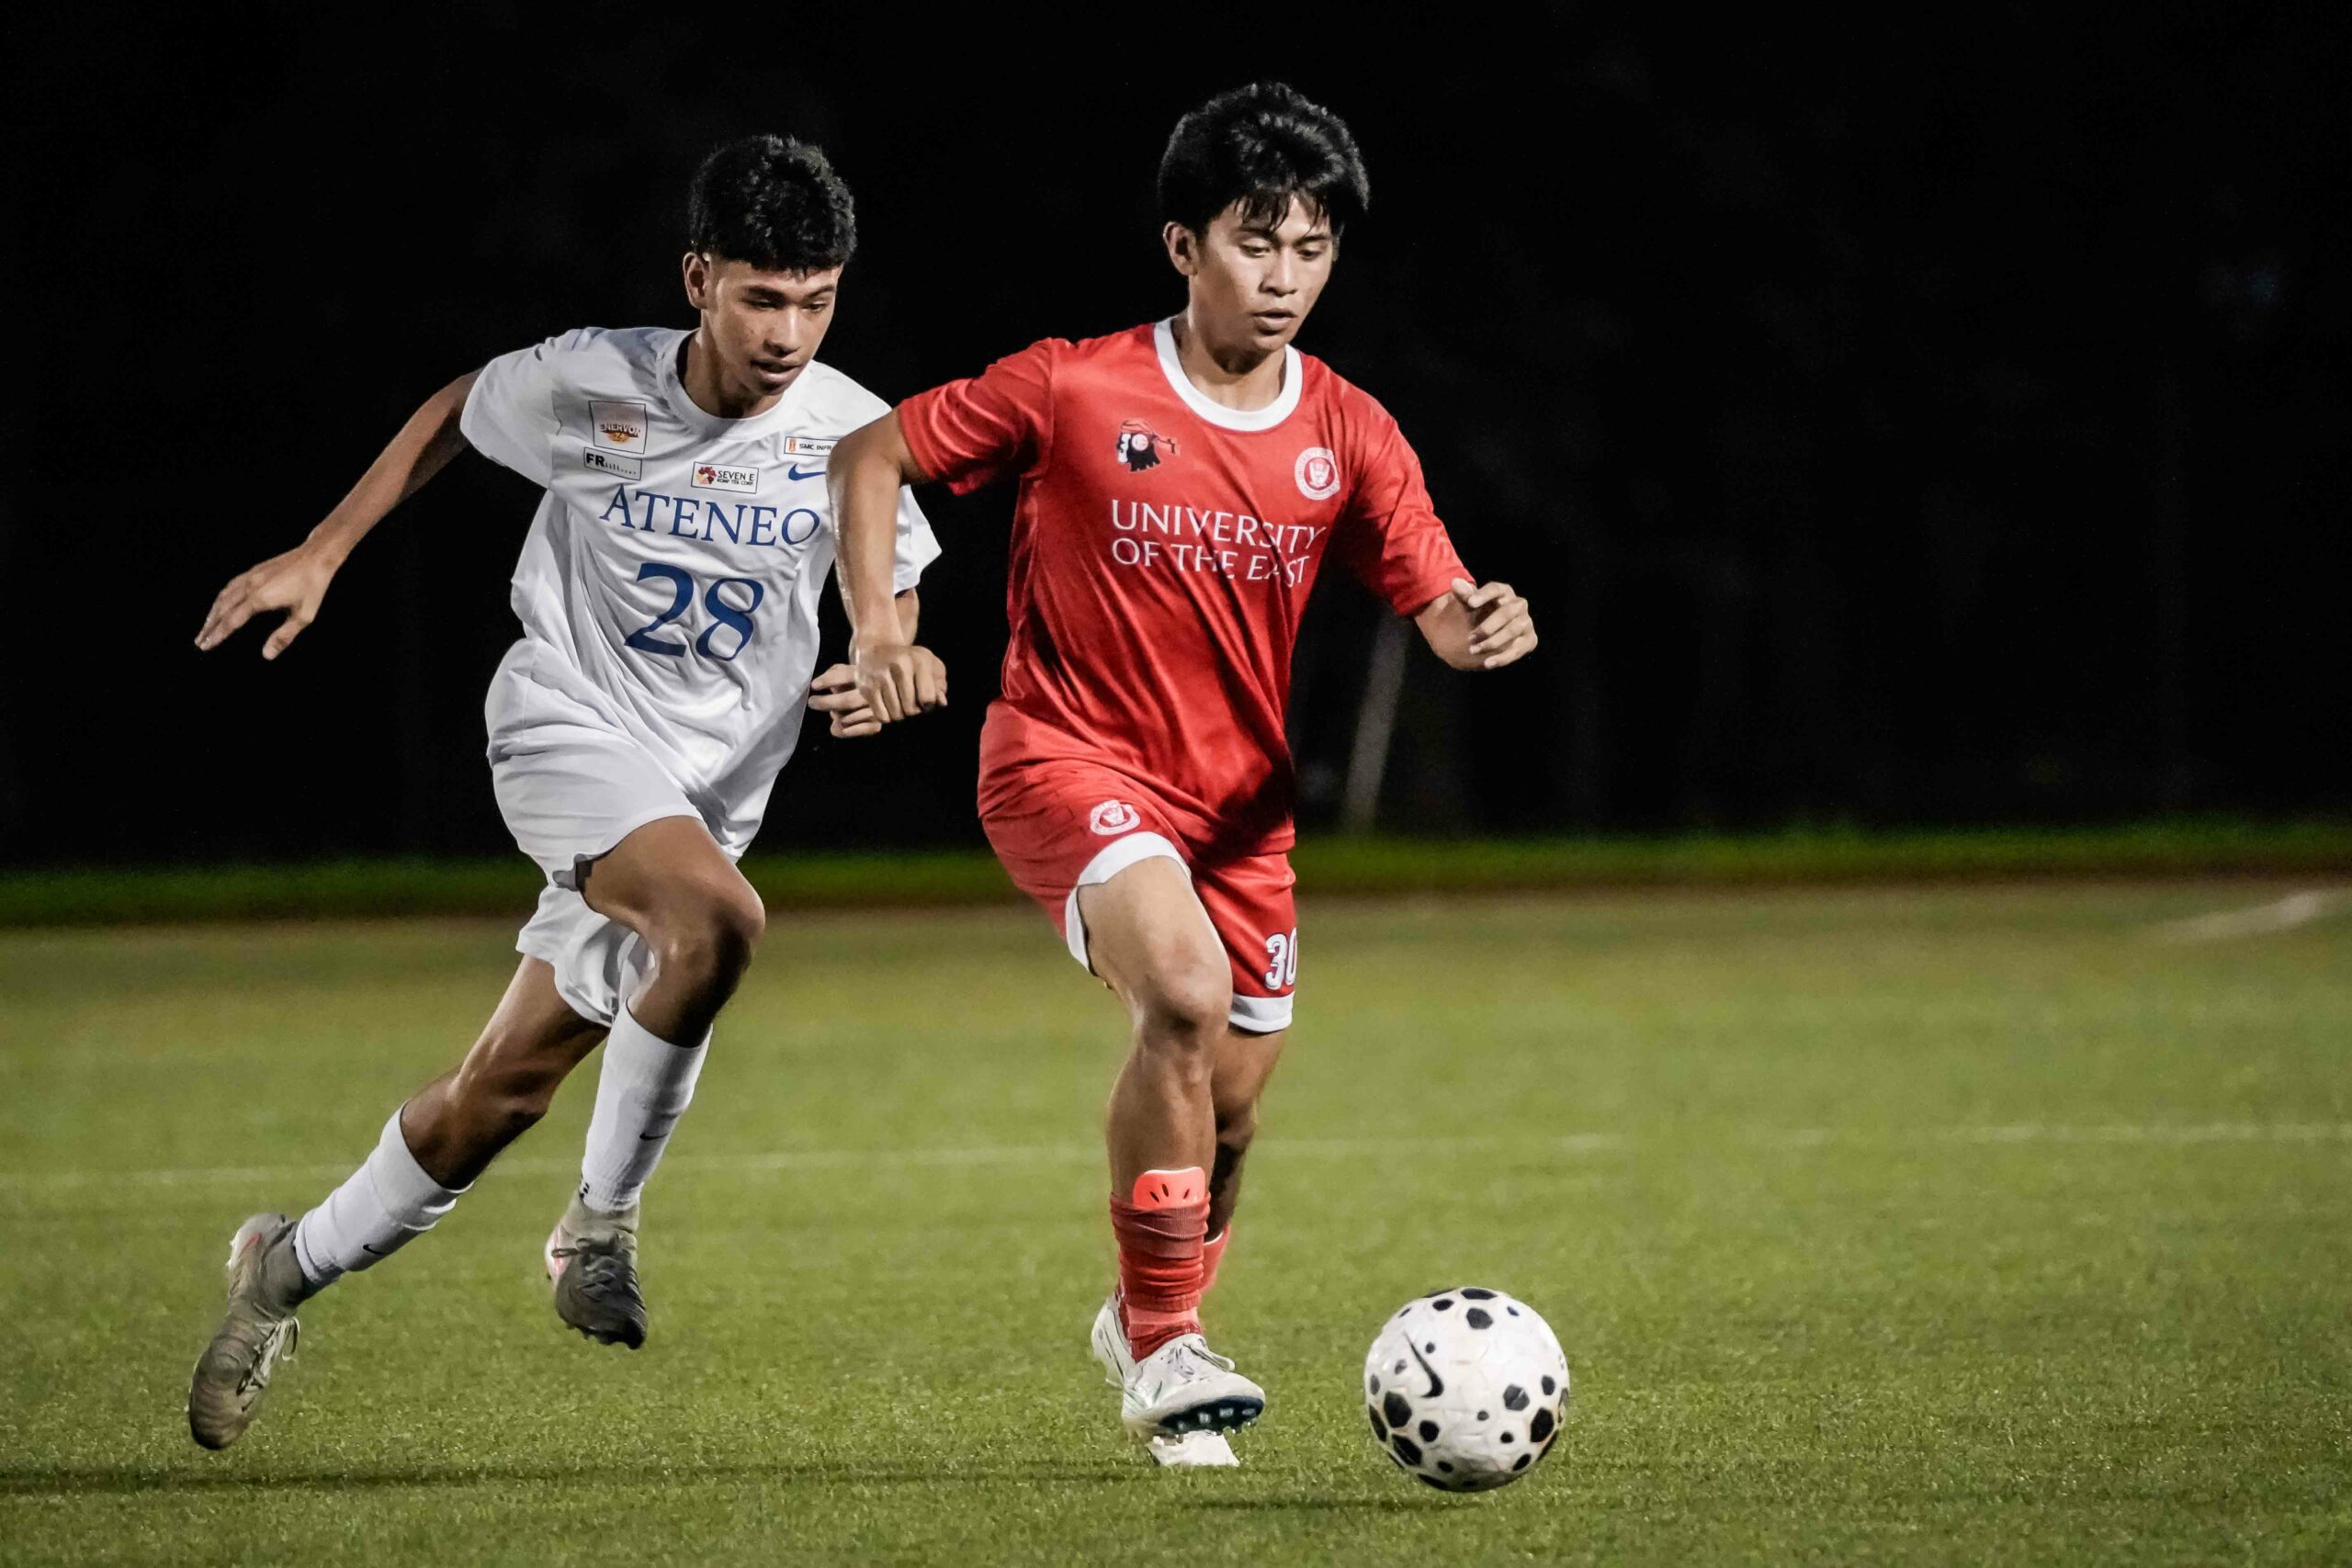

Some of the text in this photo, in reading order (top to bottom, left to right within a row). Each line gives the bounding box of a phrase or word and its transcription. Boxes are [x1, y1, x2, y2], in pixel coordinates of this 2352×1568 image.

[718, 470, 755, 481] SEVEN E
[599, 483, 820, 547] ATENEO
[1112, 499, 1327, 554] UNIVERSITY
[1112, 537, 1310, 588] OF THE EAST
[624, 562, 764, 661] 28
[1265, 927, 1298, 990] 30
